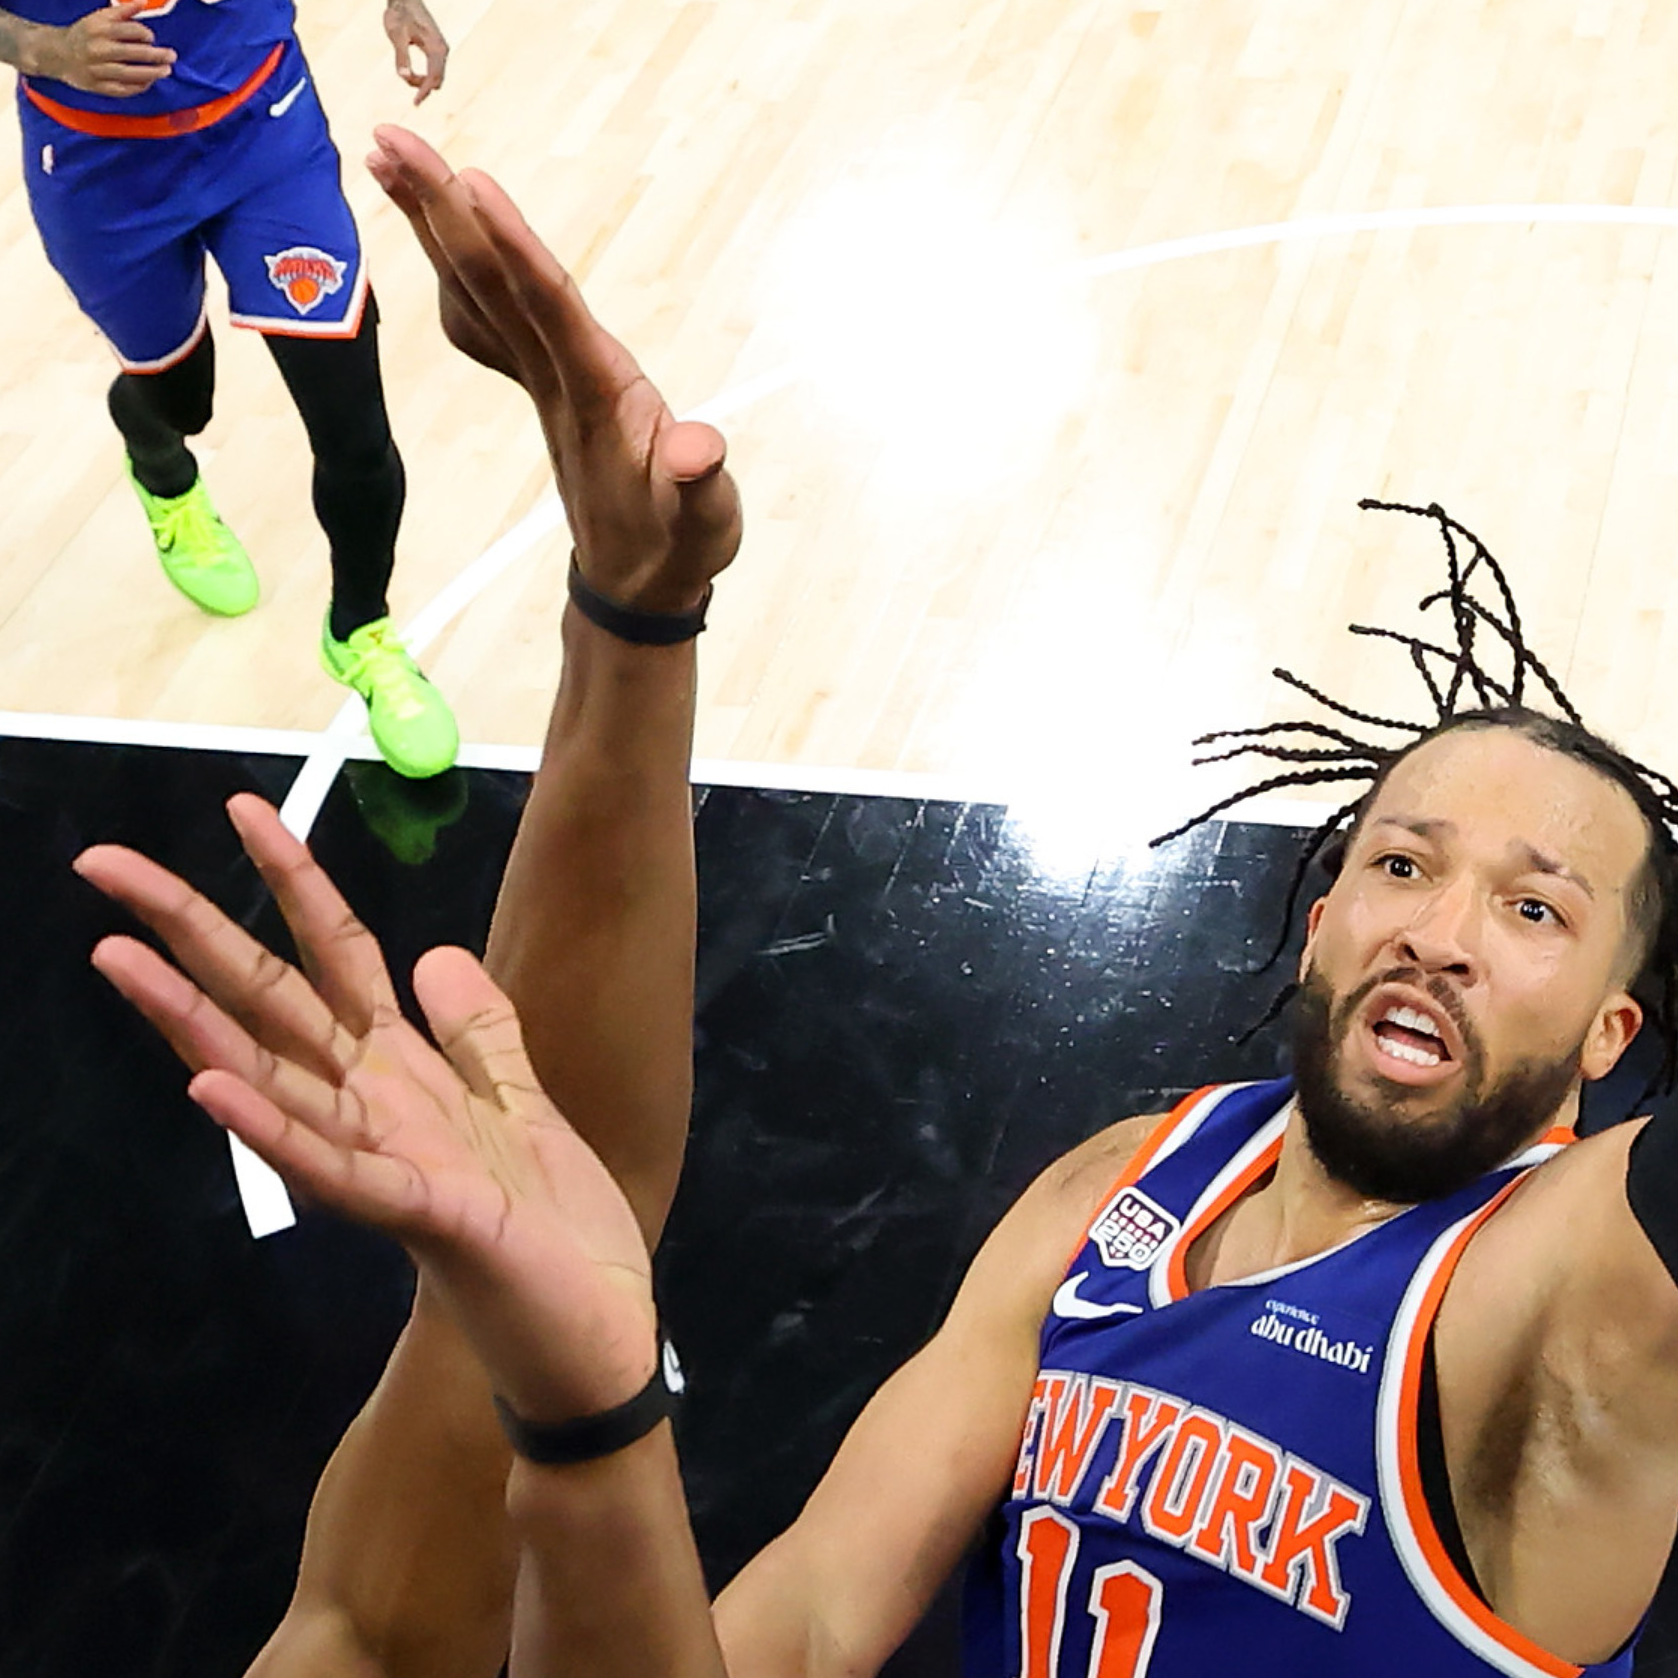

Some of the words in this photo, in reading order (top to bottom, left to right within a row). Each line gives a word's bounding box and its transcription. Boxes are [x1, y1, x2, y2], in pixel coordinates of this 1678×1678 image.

[1095, 1218, 1152, 1263] 250
[1118, 1194, 1166, 1241] USA
[1250, 1314, 1294, 1347] abu
[1294, 1325, 1374, 1374] dhabi
[1092, 1381, 1373, 1633] YORK
